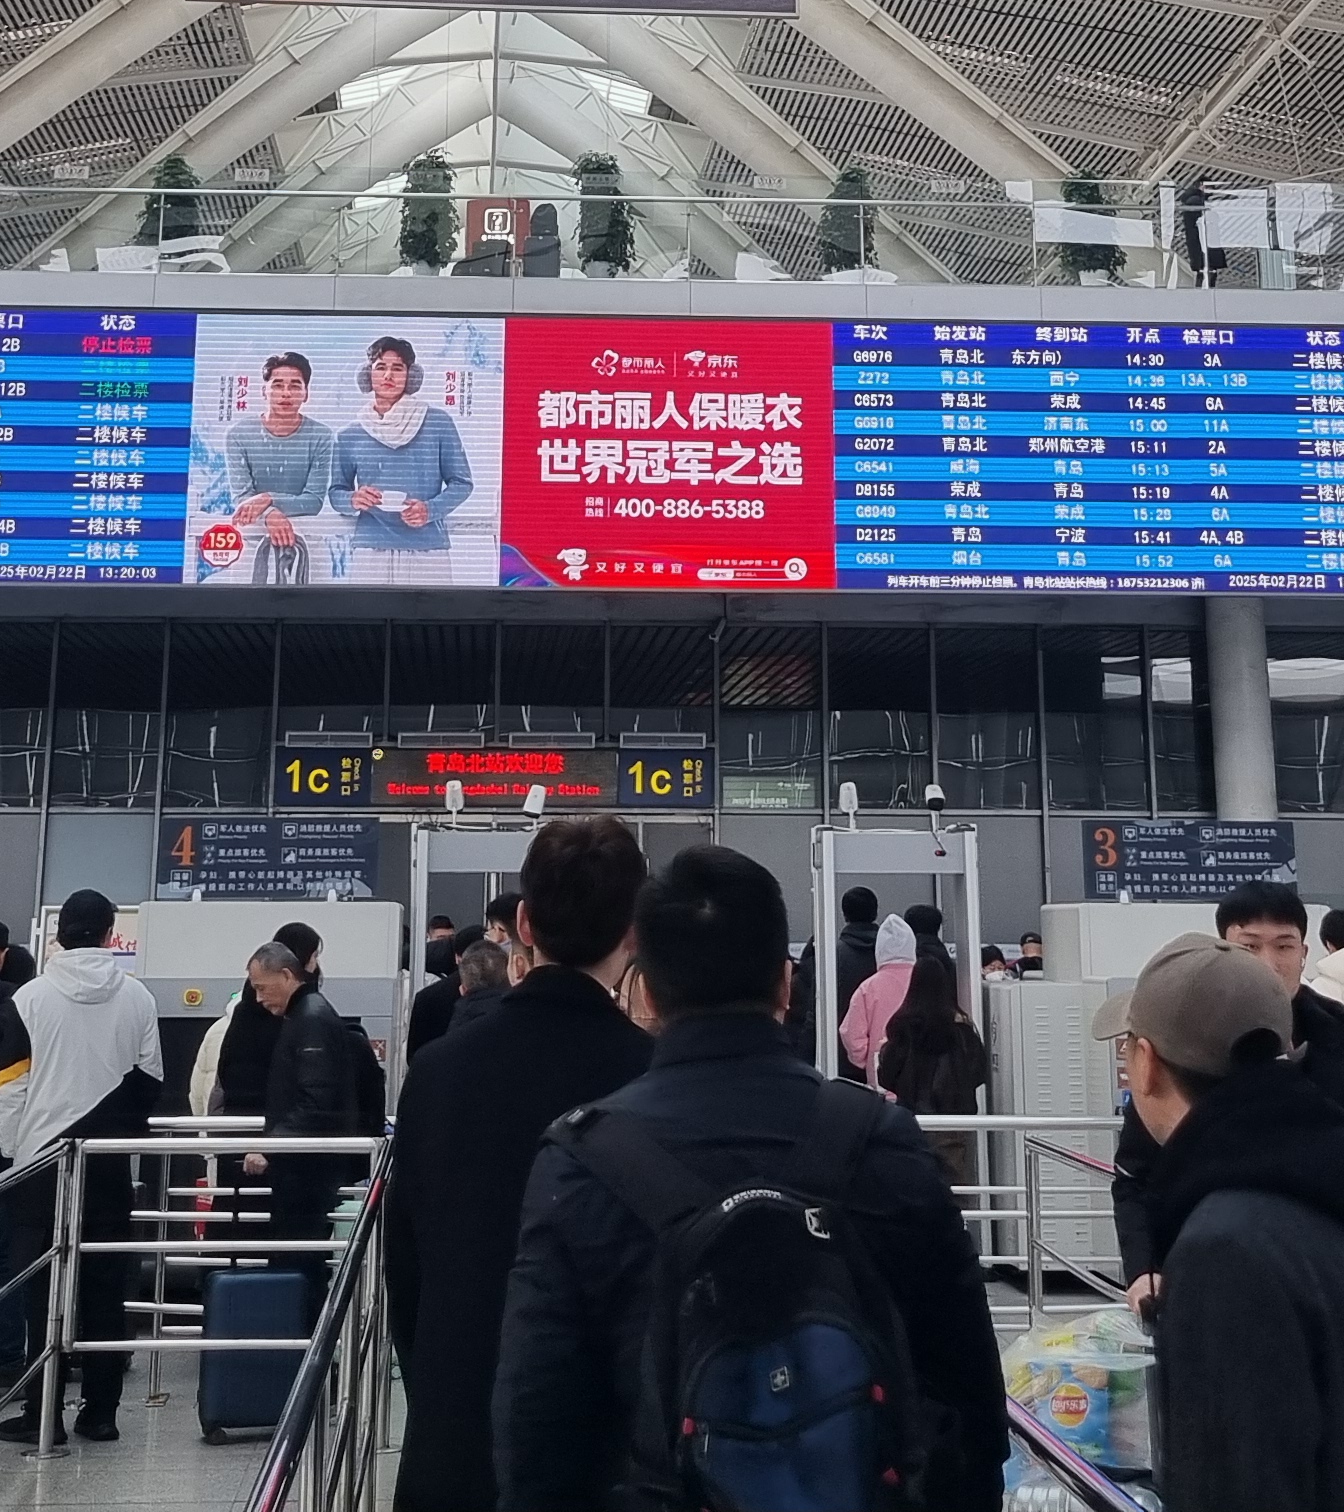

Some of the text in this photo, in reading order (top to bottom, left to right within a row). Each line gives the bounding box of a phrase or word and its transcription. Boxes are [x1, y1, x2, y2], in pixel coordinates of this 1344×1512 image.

[99, 314, 136, 332] 状态
[81, 335, 153, 355] 停止检票
[853, 324, 1342, 347] 车次 始发站 终到站 开点 检票口 状态
[853, 350, 893, 363] G6976
[939, 347, 986, 365] 青岛北
[1125, 353, 1165, 367] 14:30
[1203, 353, 1222, 368] 3A
[537, 389, 803, 431] 都市丽人保暖衣
[854, 393, 894, 407] C6573
[940, 392, 987, 409] 青岛北
[1050, 392, 1082, 410] 荣成
[1128, 396, 1167, 411] 14:45
[1205, 396, 1224, 411] 6A
[75, 424, 147, 444] 二楼候车
[854, 437, 895, 451] G2072
[941, 436, 988, 453] 青岛北
[1028, 437, 1106, 454] 郑州航空港
[1130, 440, 1167, 454] 15:11
[1208, 440, 1226, 455] 2A
[537, 439, 803, 485] 世界冠军之选
[72, 471, 145, 490] 二楼候车
[855, 483, 895, 497] D8155
[950, 480, 982, 498] 荣成
[1053, 482, 1084, 499] 青岛
[1131, 486, 1171, 500] 15:19
[1210, 485, 1230, 500] 4A
[614, 498, 765, 519] 400-886-5388
[69, 516, 142, 536] 二楼候车
[856, 528, 896, 542] D2125
[951, 526, 982, 543] 青岛
[1055, 527, 1086, 544] 宁波
[1133, 530, 1171, 544] 15:41
[208, 532, 237, 547] 159
[99, 566, 157, 579] 13:20:03
[595, 562, 683, 575] 又好又便宜
[1228, 574, 1325, 589] 2025年02月22日
[426, 753, 564, 774] 青岛北站欢迎您
[171, 825, 195, 866] 4
[1094, 828, 1118, 867] 3
